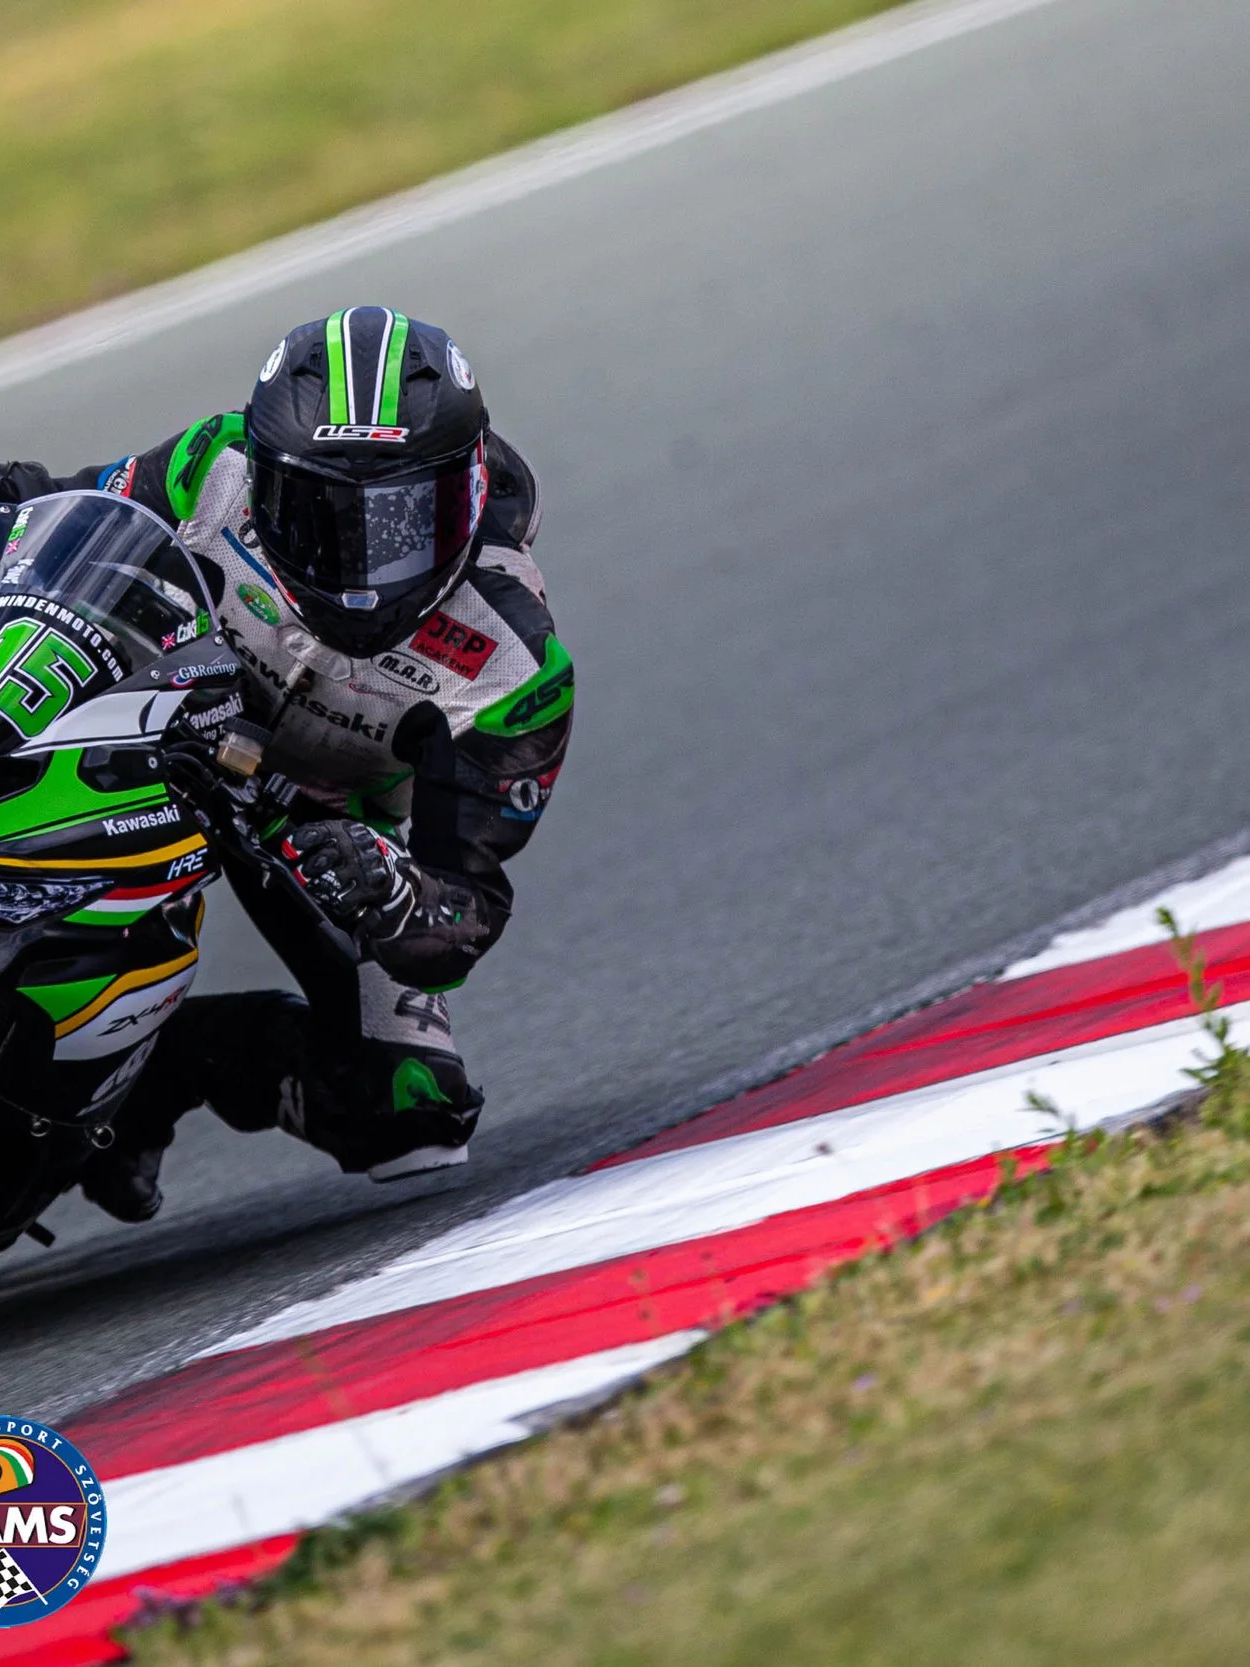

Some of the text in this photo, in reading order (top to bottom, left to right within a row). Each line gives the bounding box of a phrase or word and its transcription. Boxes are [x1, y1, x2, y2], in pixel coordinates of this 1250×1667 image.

[313, 425, 410, 442] LS2
[428, 616, 487, 654] JRP
[178, 660, 238, 681] GBRacing
[377, 654, 433, 690] M.A.R
[183, 692, 244, 729] awasaki
[102, 804, 181, 837] Kawasaki
